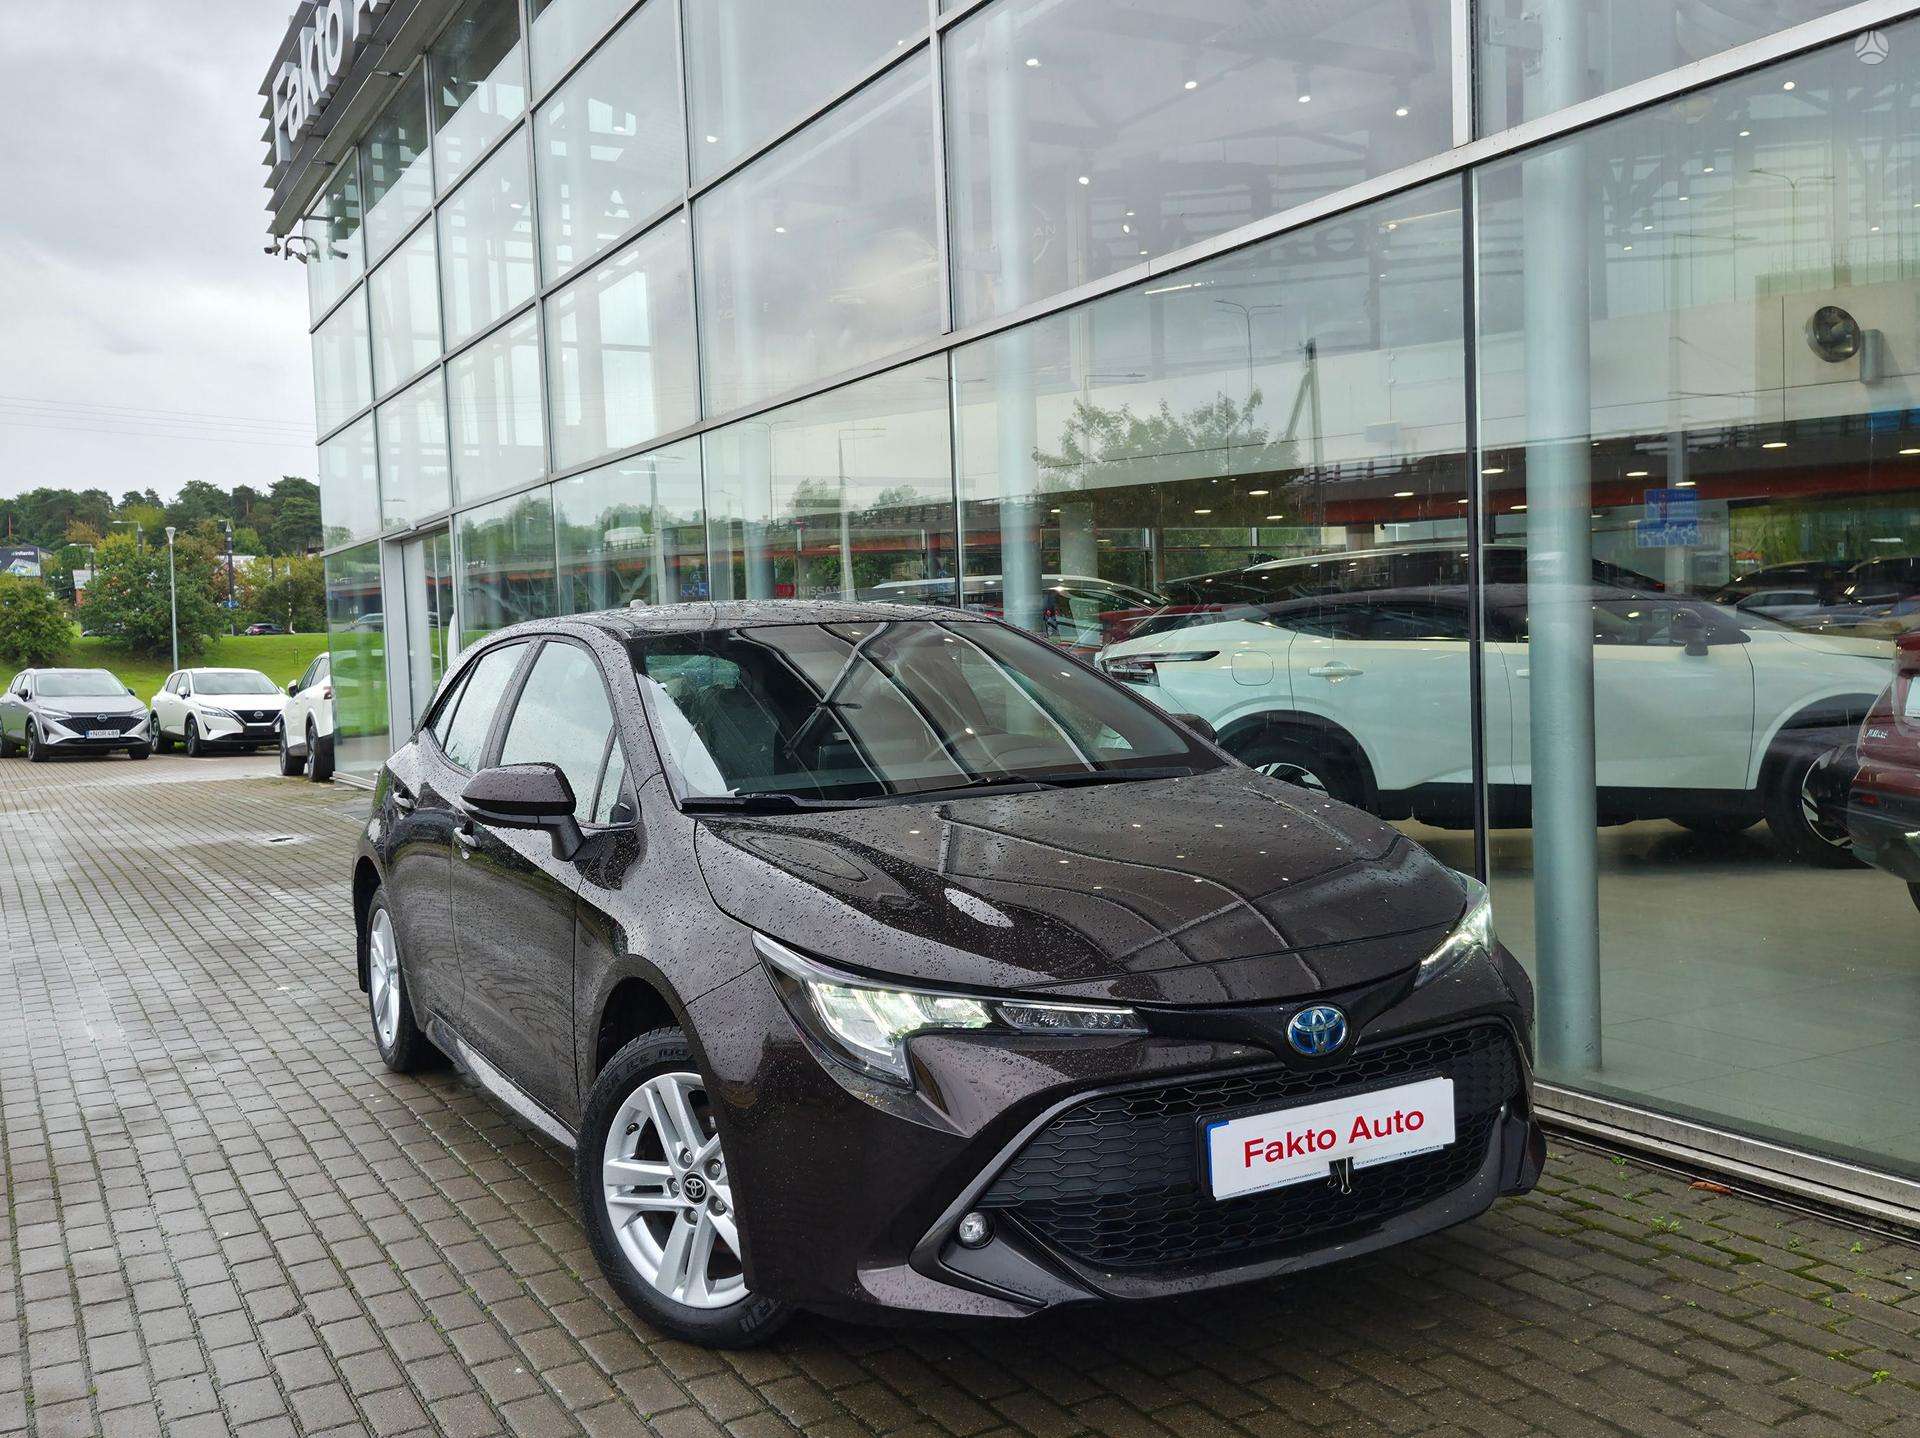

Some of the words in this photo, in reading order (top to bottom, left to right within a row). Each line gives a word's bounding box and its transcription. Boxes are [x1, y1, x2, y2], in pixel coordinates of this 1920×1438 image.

[272, 0, 344, 165] Fakto
[1244, 1128, 1337, 1168] Fakto
[1348, 1109, 1425, 1144] Auto
